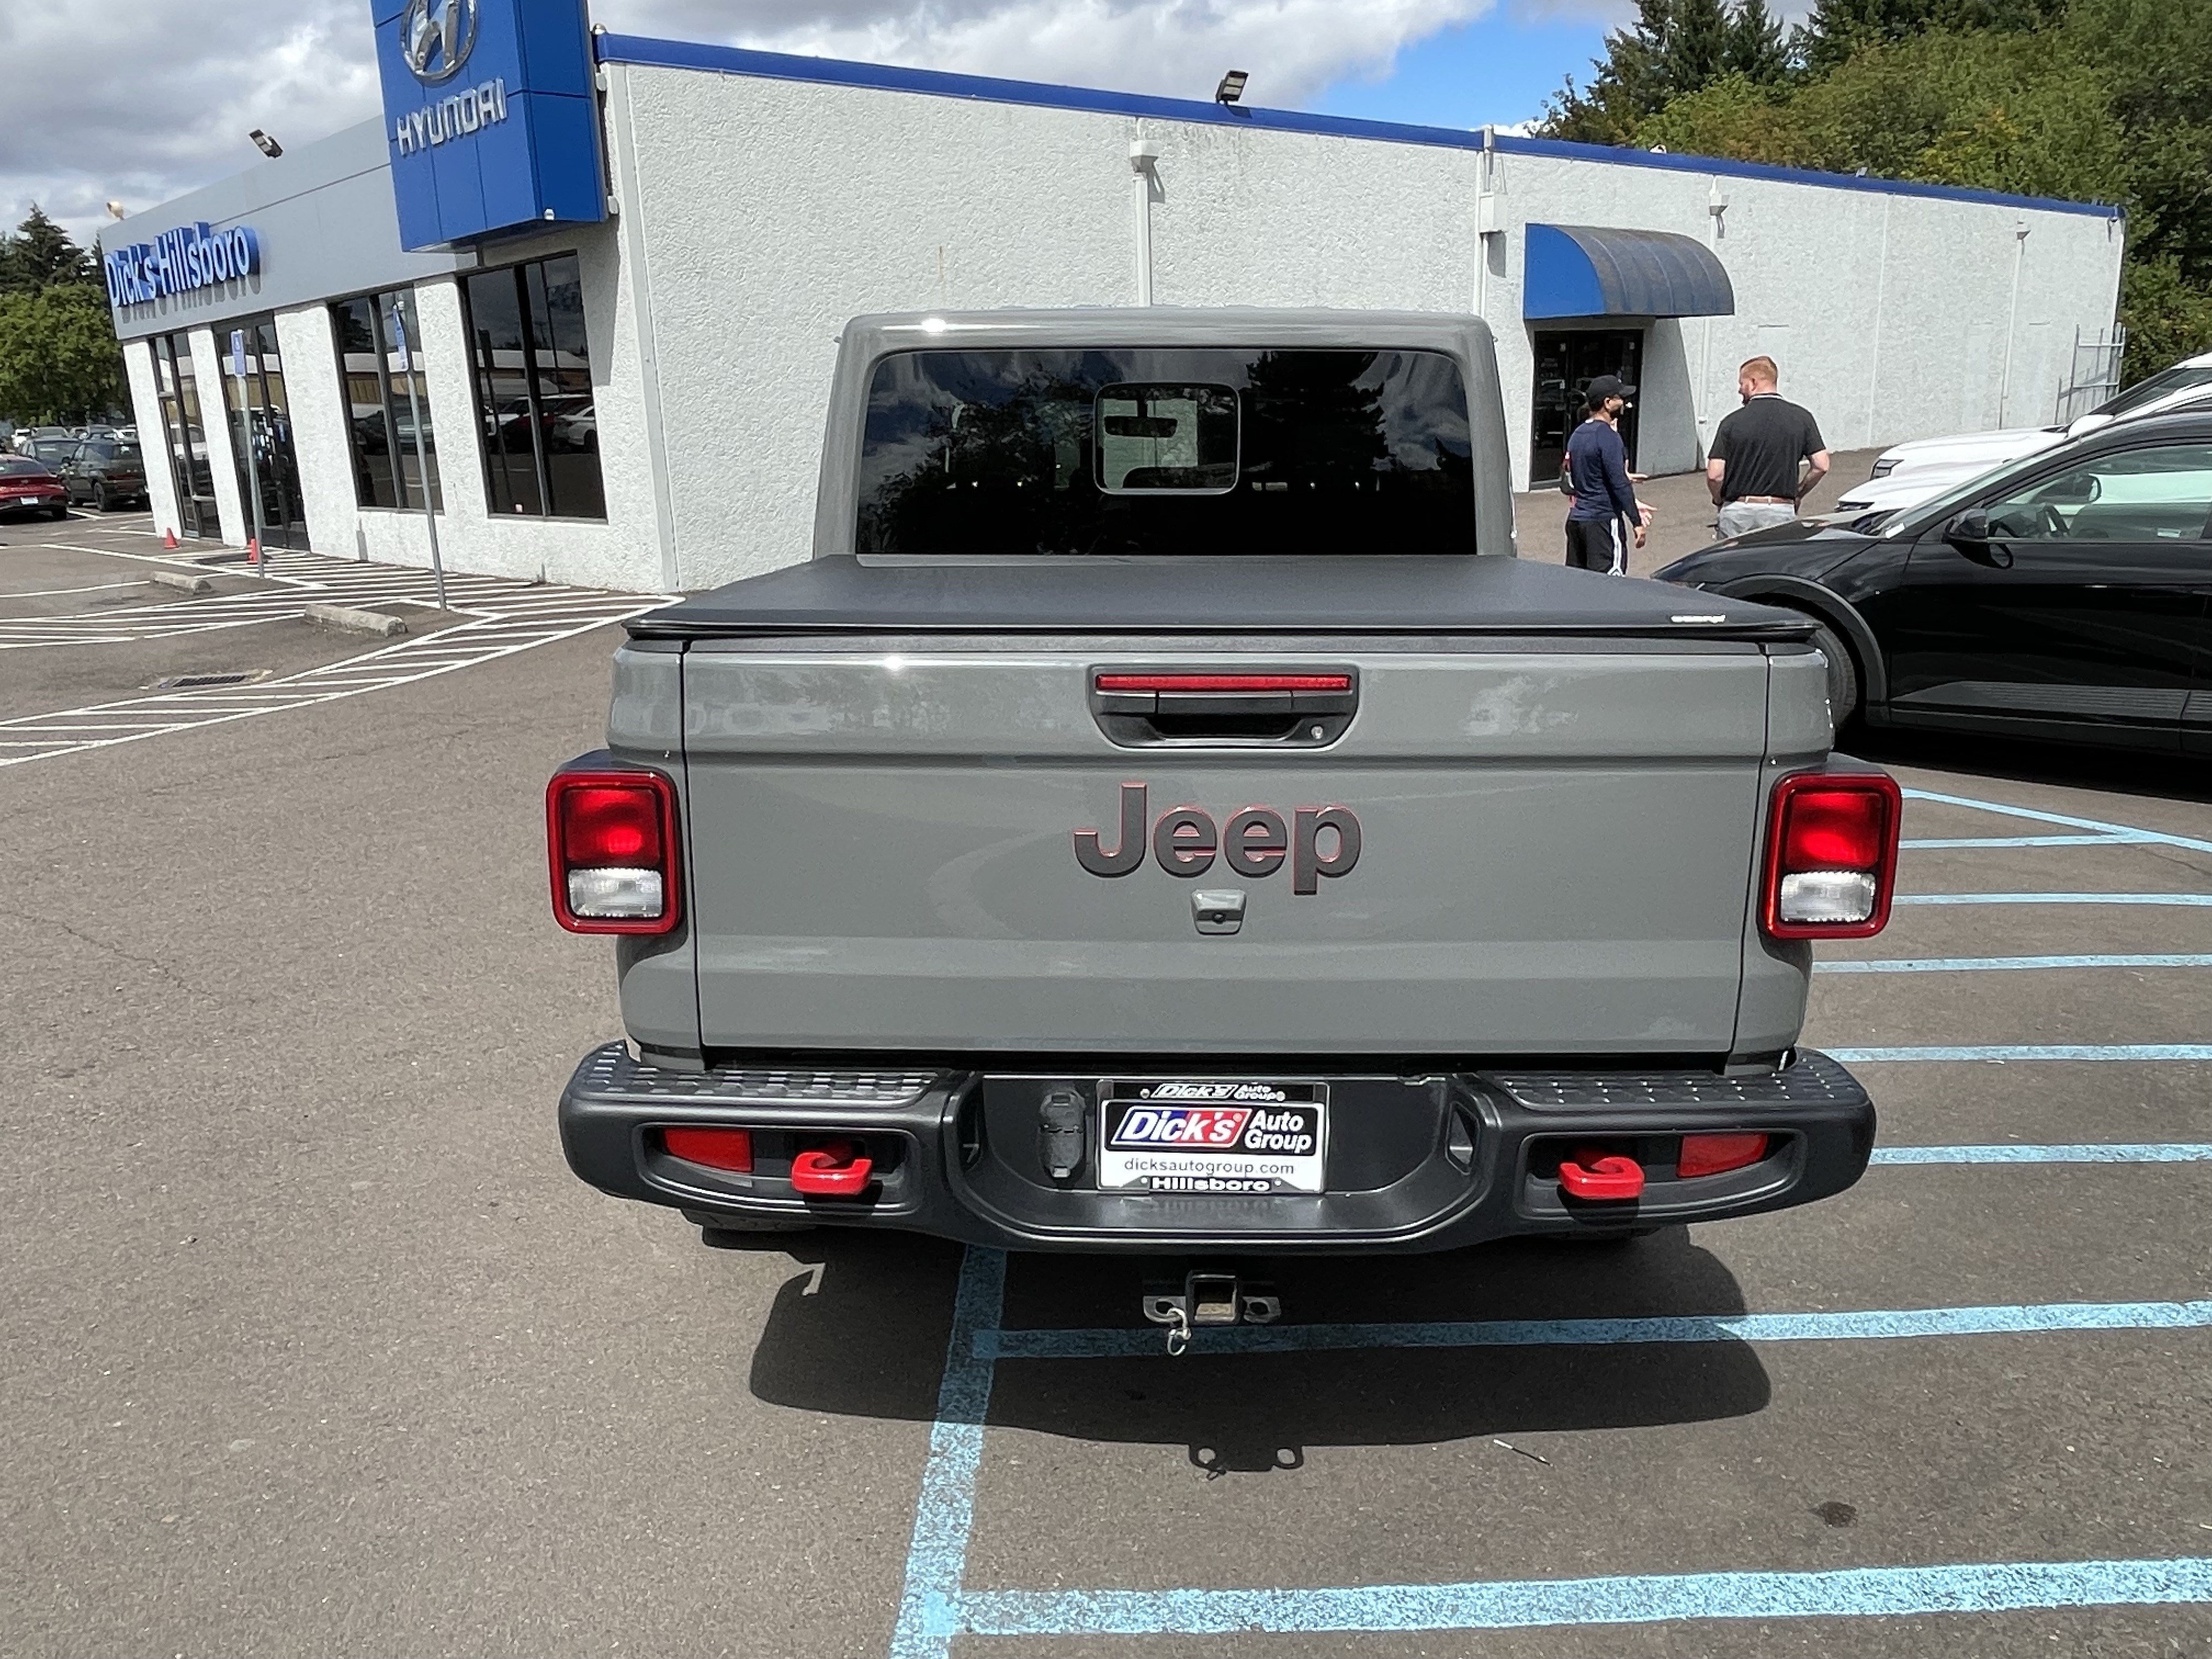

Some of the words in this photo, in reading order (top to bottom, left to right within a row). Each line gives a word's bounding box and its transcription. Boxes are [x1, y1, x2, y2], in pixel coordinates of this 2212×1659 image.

[396, 77, 507, 156] HYUNDAI
[104, 243, 157, 307] Dick's
[155, 222, 256, 295] Hillsboro
[1074, 781, 1362, 895] Jeep
[1120, 1110, 1237, 1142] Dick's
[1249, 1110, 1304, 1131] Auto
[1245, 1130, 1312, 1154] Group
[1124, 1158, 1295, 1177] dicksautogroup.com
[1152, 1177, 1271, 1191] Hillsboro
